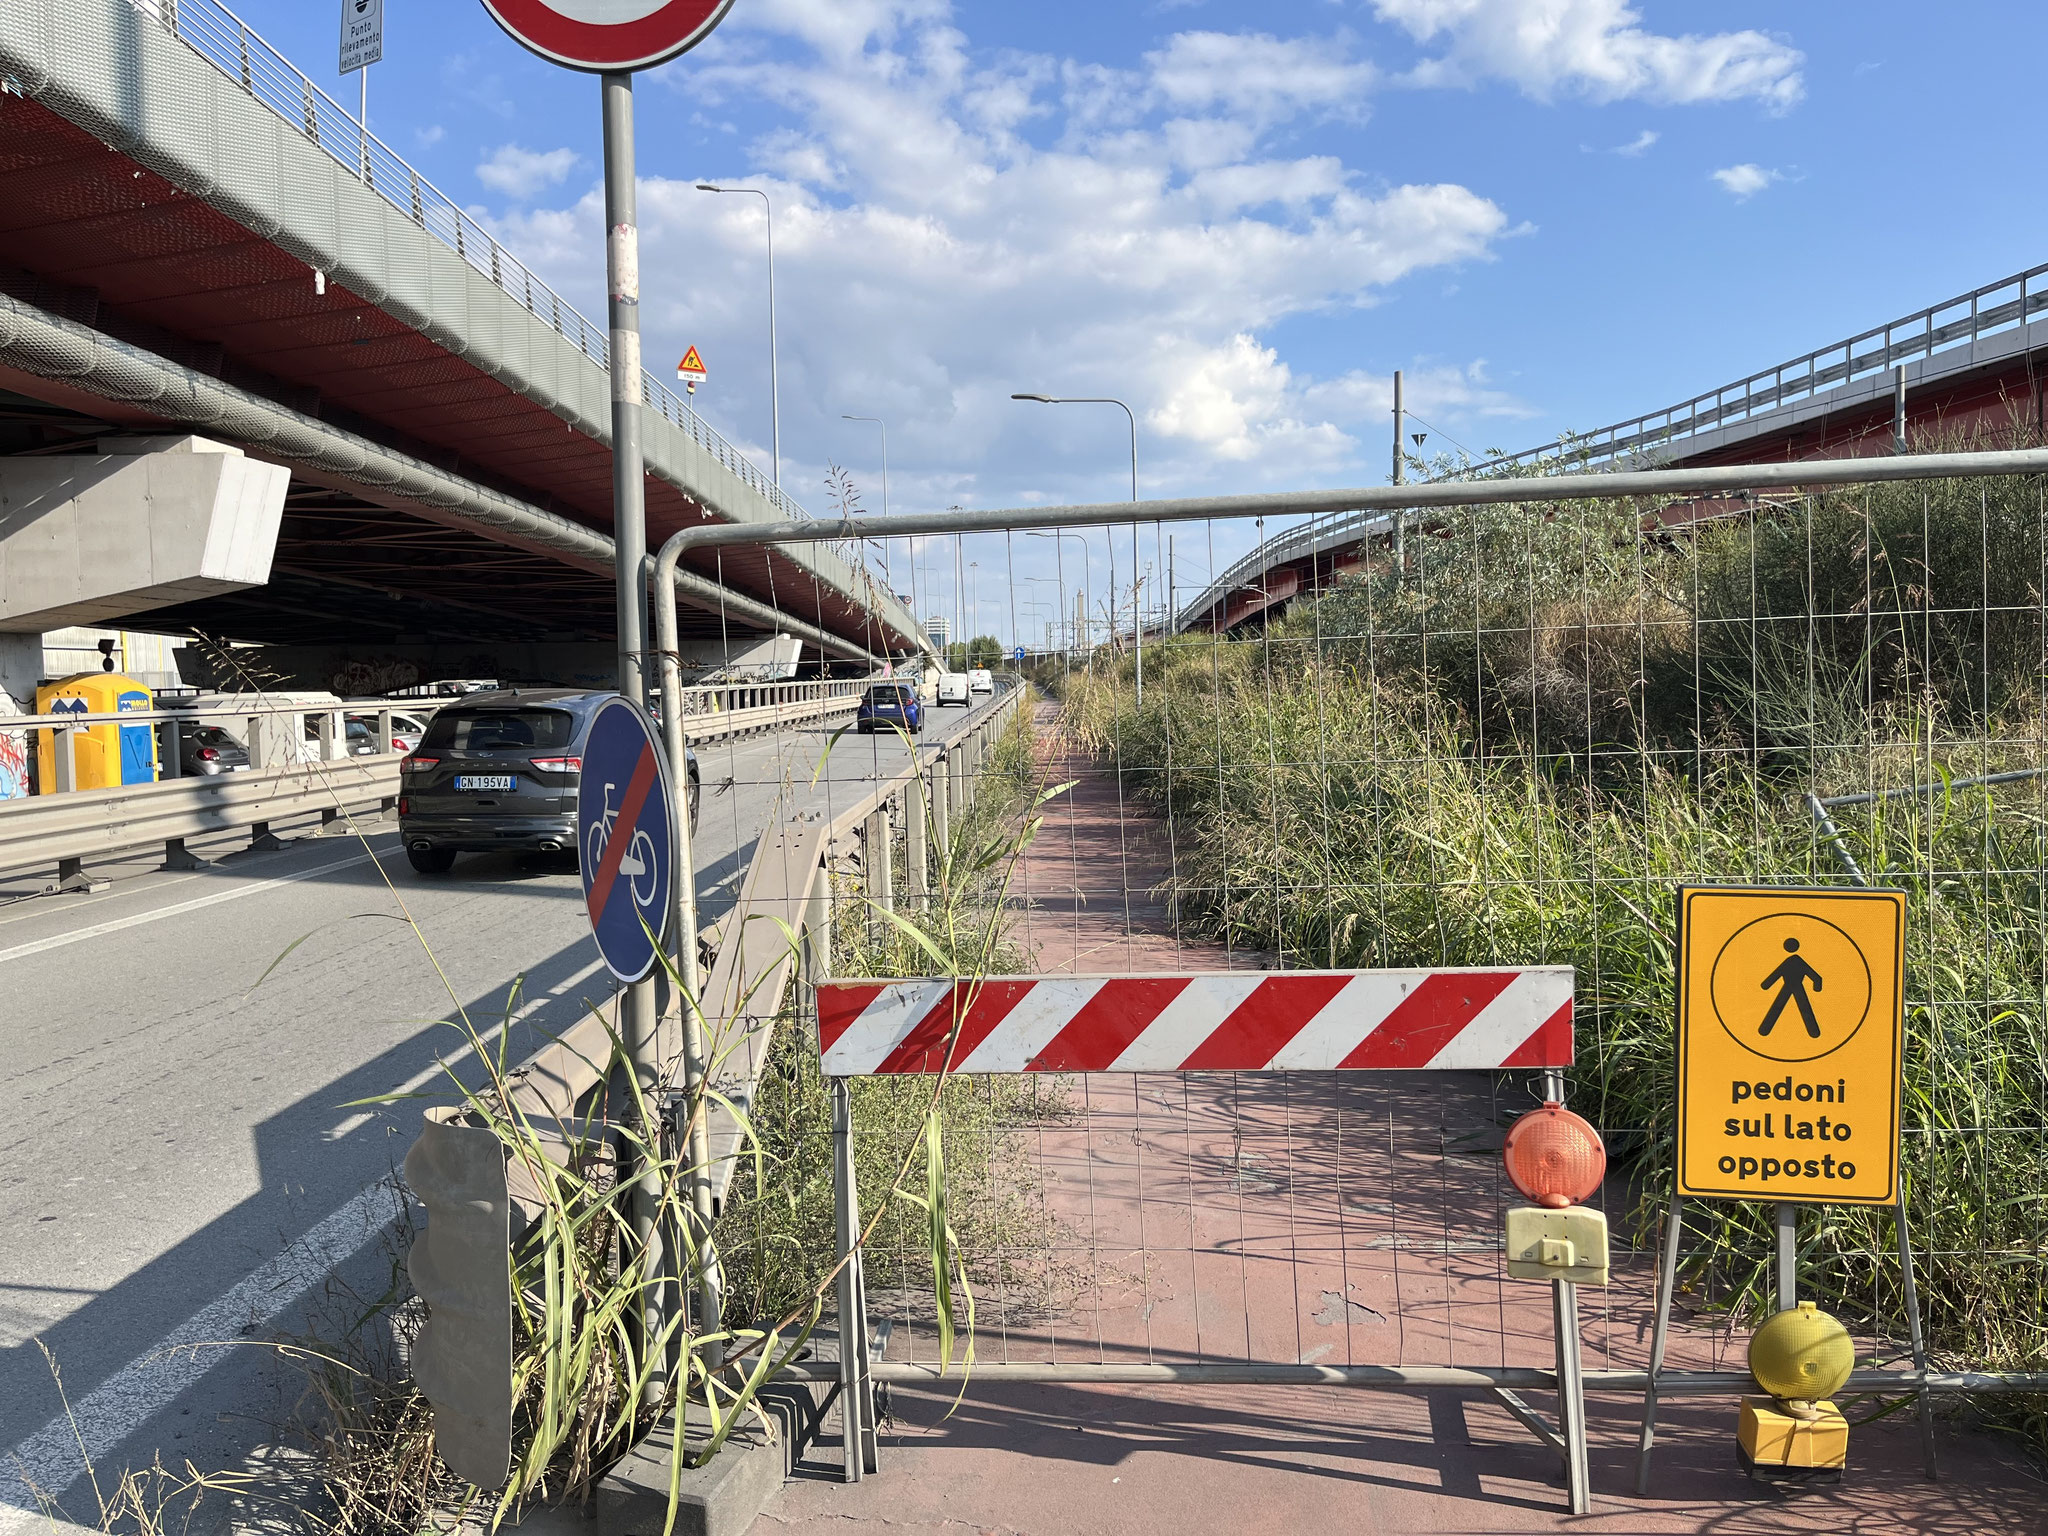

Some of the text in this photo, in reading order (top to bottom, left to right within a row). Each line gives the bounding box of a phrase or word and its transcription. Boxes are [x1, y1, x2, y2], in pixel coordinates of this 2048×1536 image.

[351, 21, 371, 38] Punto
[341, 32, 379, 55] rilevamento
[364, 46, 379, 61] media
[1732, 1076, 1845, 1104] pedoni
[1723, 1113, 1852, 1142] sul lato
[1718, 1153, 1856, 1181] opposto
